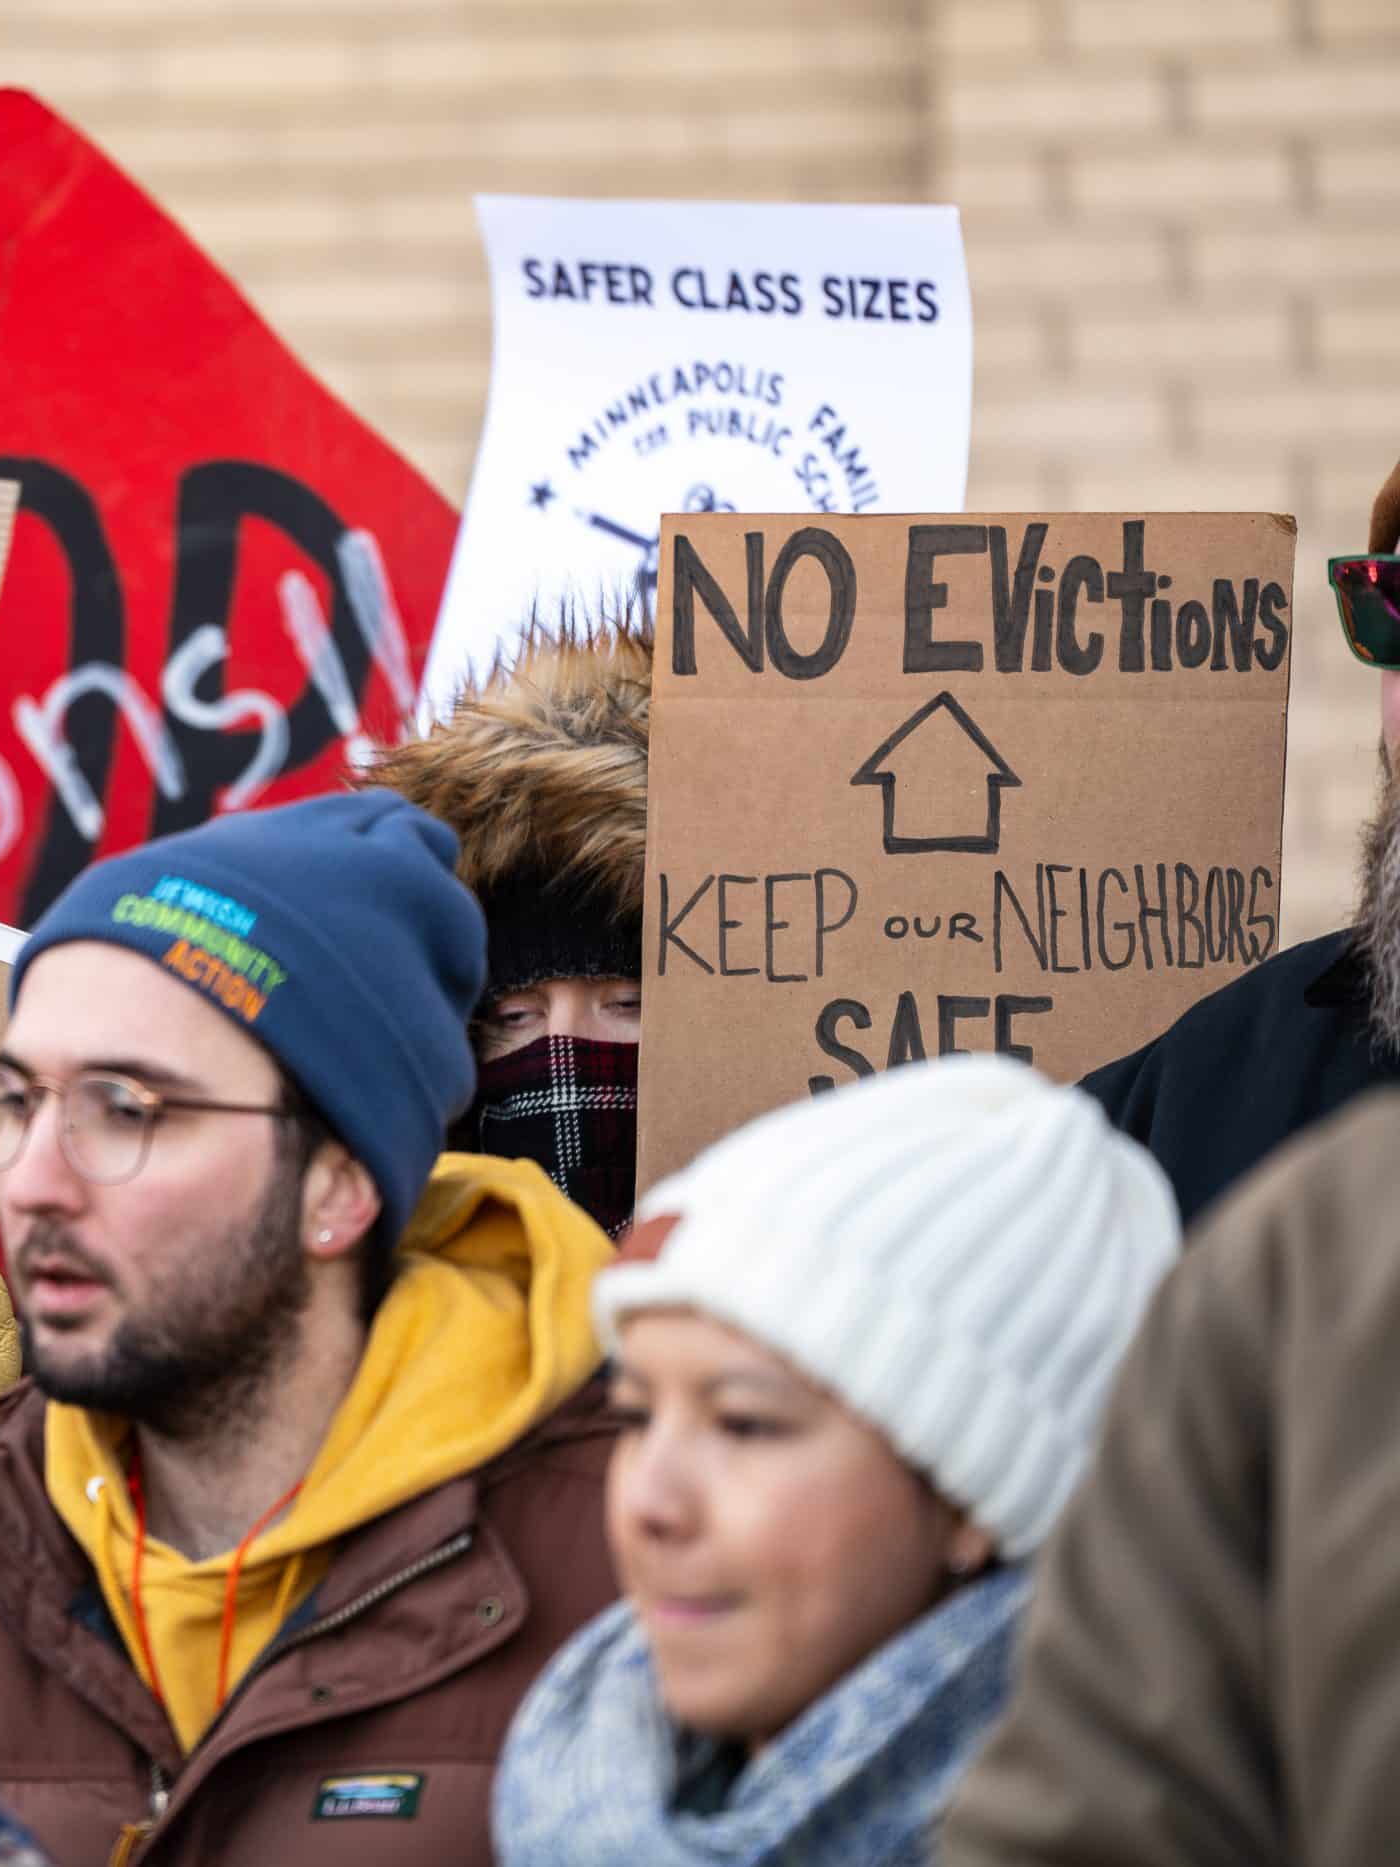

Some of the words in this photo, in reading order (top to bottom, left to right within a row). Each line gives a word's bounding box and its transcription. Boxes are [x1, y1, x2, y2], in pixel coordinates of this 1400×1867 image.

[521, 257, 654, 307] SAFER
[672, 267, 803, 317] CLASS
[822, 276, 940, 324] SIZES
[566, 361, 785, 469] MINNEAPOLIS
[687, 407, 795, 458] PUBLIC
[670, 525, 858, 681] NO
[111, 893, 288, 994] COMMUNITY
[657, 867, 858, 983] KEEP
[884, 911, 983, 943] OUR
[994, 862, 1278, 974] NEIGHBORS
[162, 938, 267, 1023] ACTION
